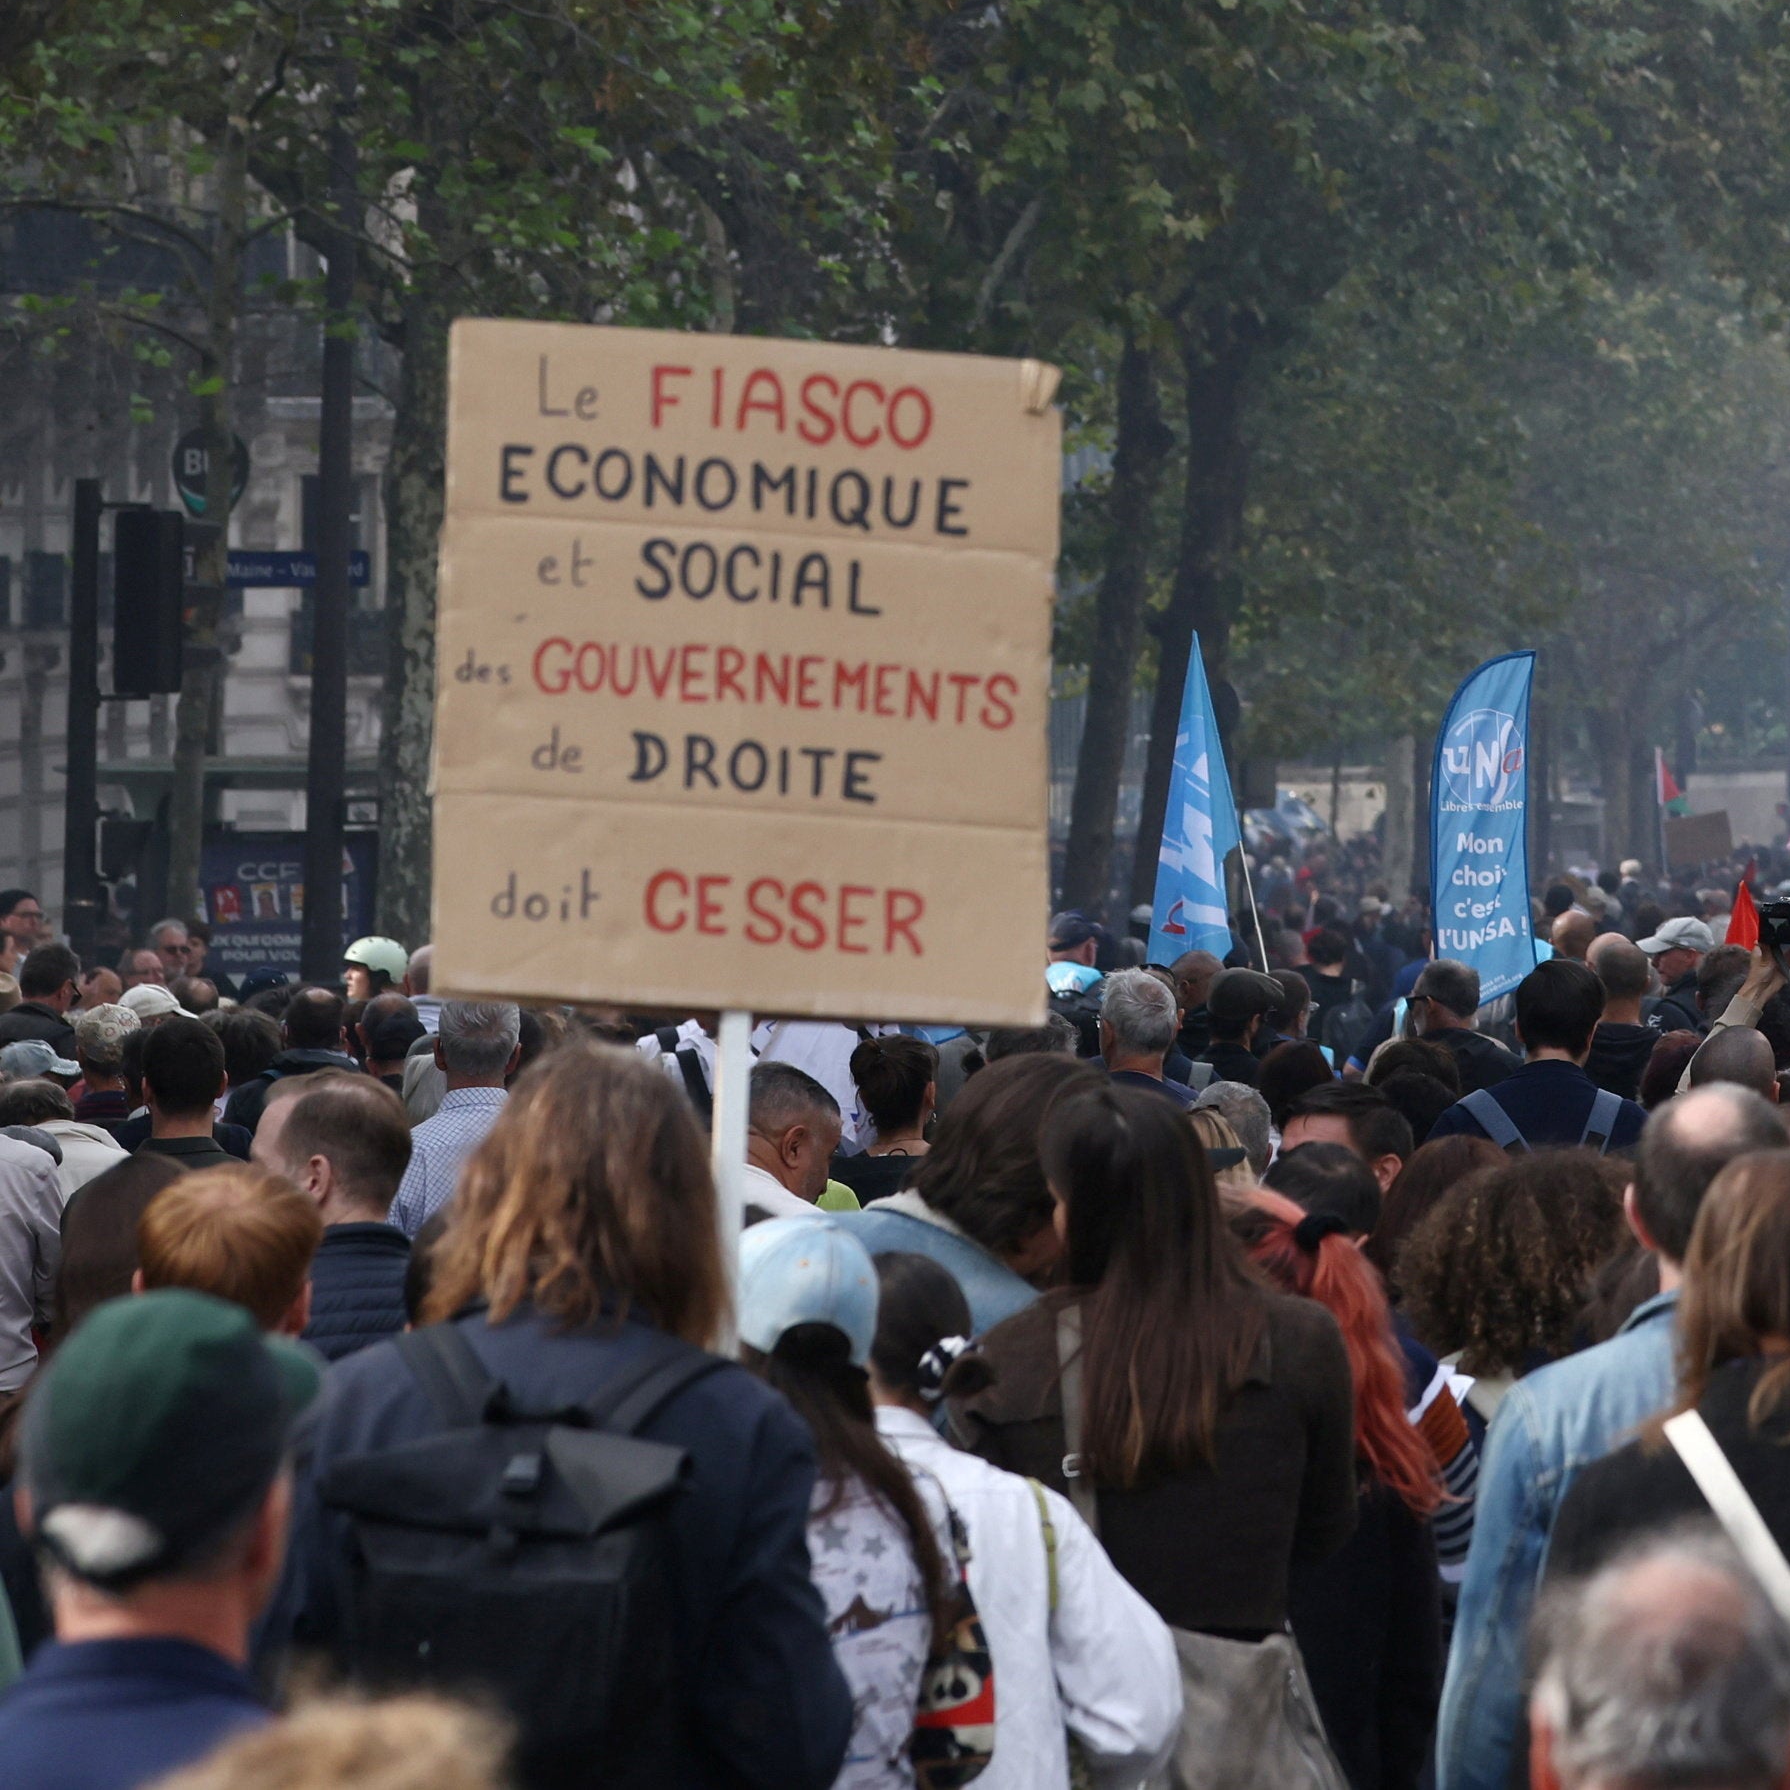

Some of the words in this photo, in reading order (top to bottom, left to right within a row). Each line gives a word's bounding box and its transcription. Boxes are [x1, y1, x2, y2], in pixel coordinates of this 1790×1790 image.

[537, 353, 599, 421] Le
[649, 364, 934, 450] FIASCO
[499, 444, 971, 537] ECONOMIQUE
[537, 538, 596, 588] et
[635, 538, 881, 617] SOCIAL
[455, 649, 512, 686] des
[531, 637, 1020, 732] GOUVERNEMENTS
[531, 725, 584, 773] de
[628, 730, 883, 804] DROITE
[1456, 832, 1504, 854] Mon
[490, 868, 602, 921] doit
[643, 868, 927, 957] CESSER
